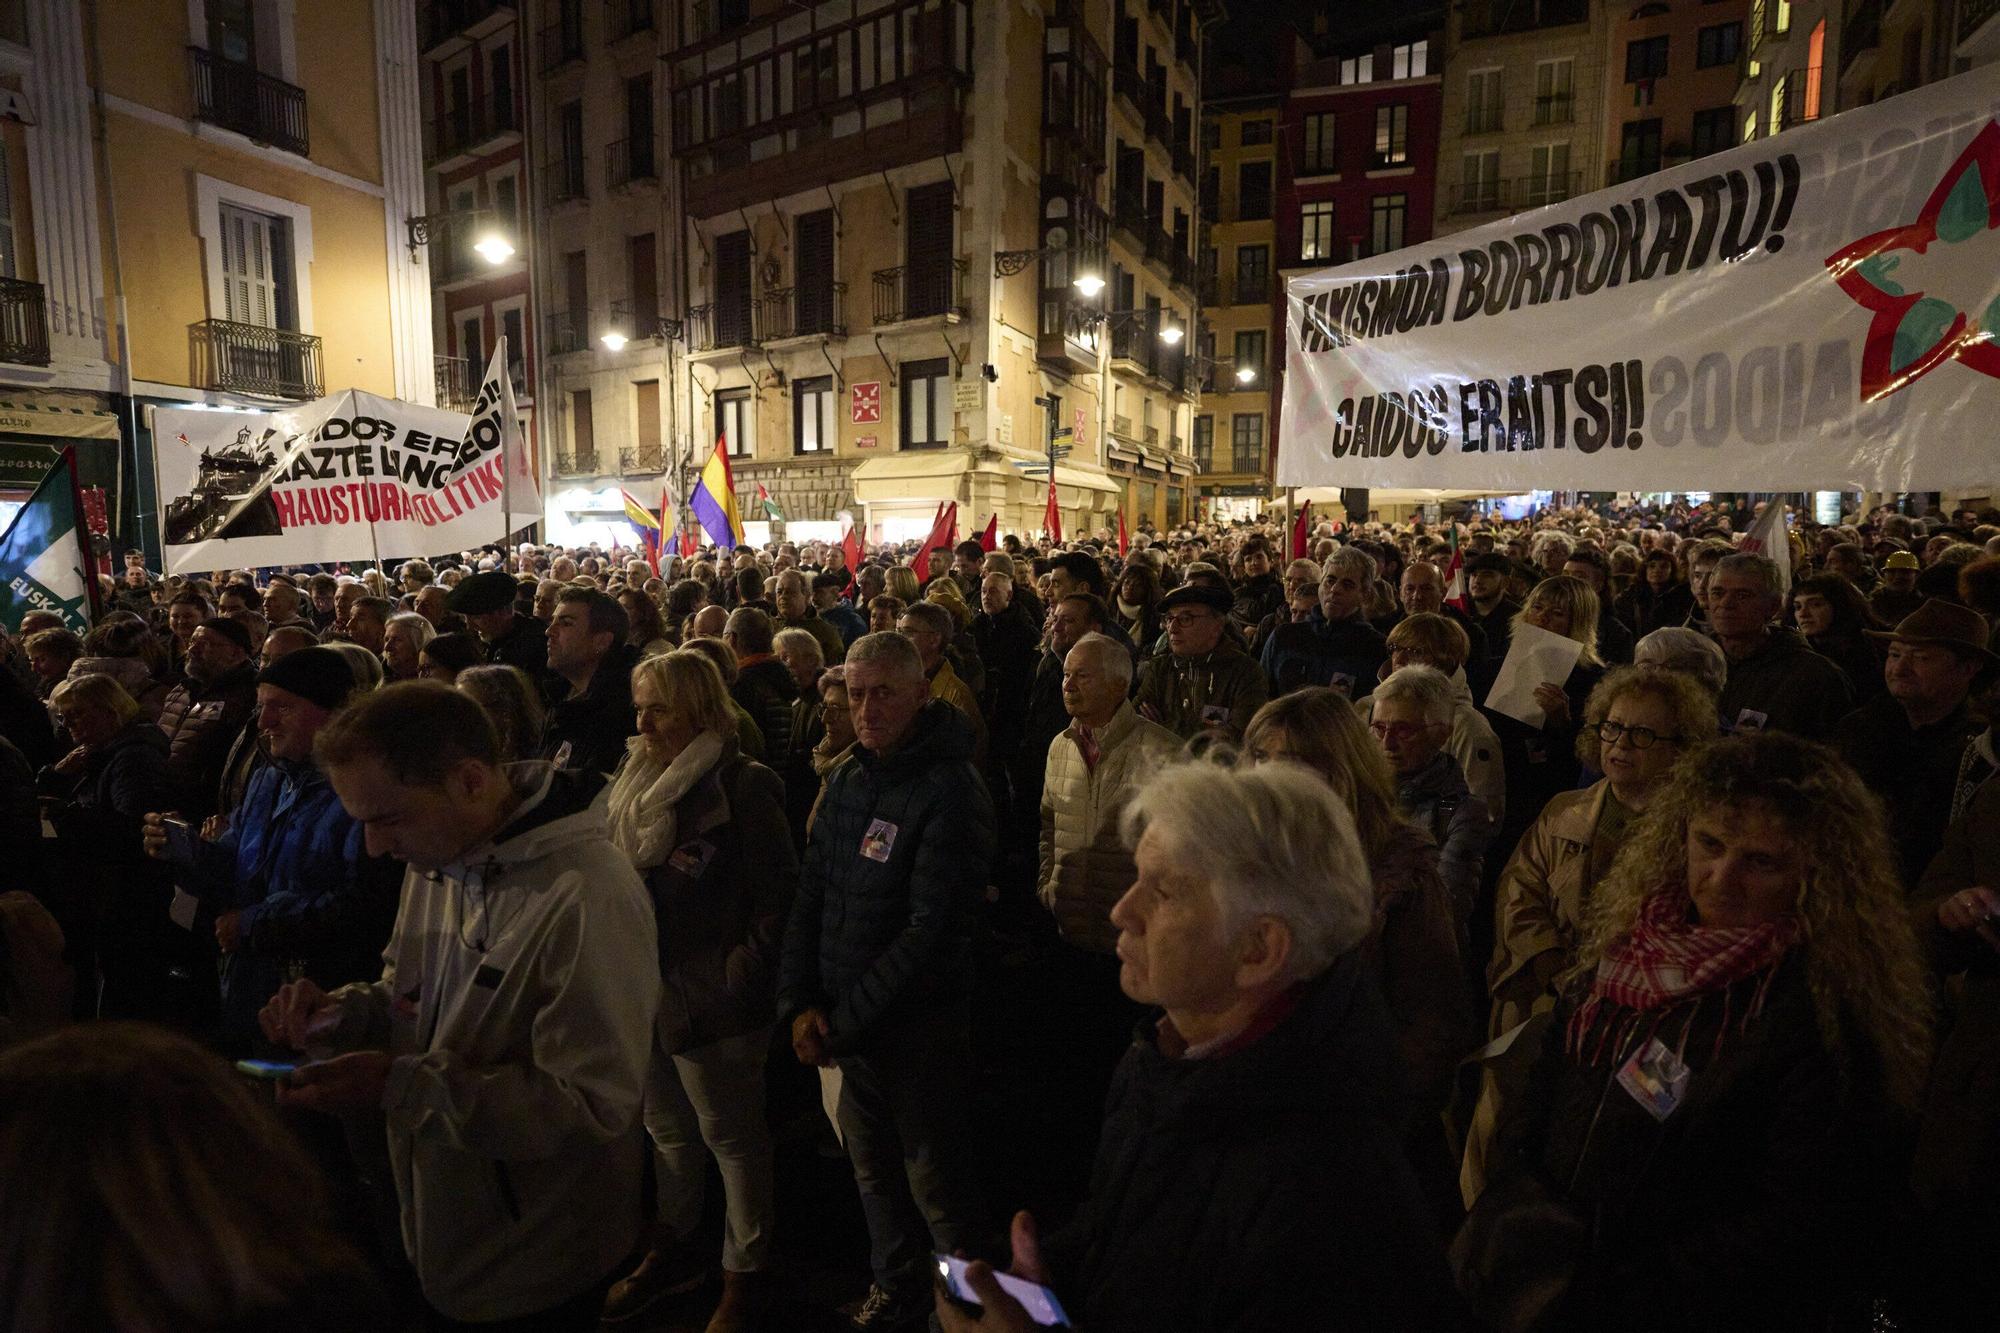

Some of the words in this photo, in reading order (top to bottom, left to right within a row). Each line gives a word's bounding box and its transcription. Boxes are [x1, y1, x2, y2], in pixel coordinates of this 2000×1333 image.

[1453, 153, 1800, 322] BORROKATU!
[1332, 384, 1448, 458] CAIDOS
[1461, 359, 1643, 454] ERAITSI!
